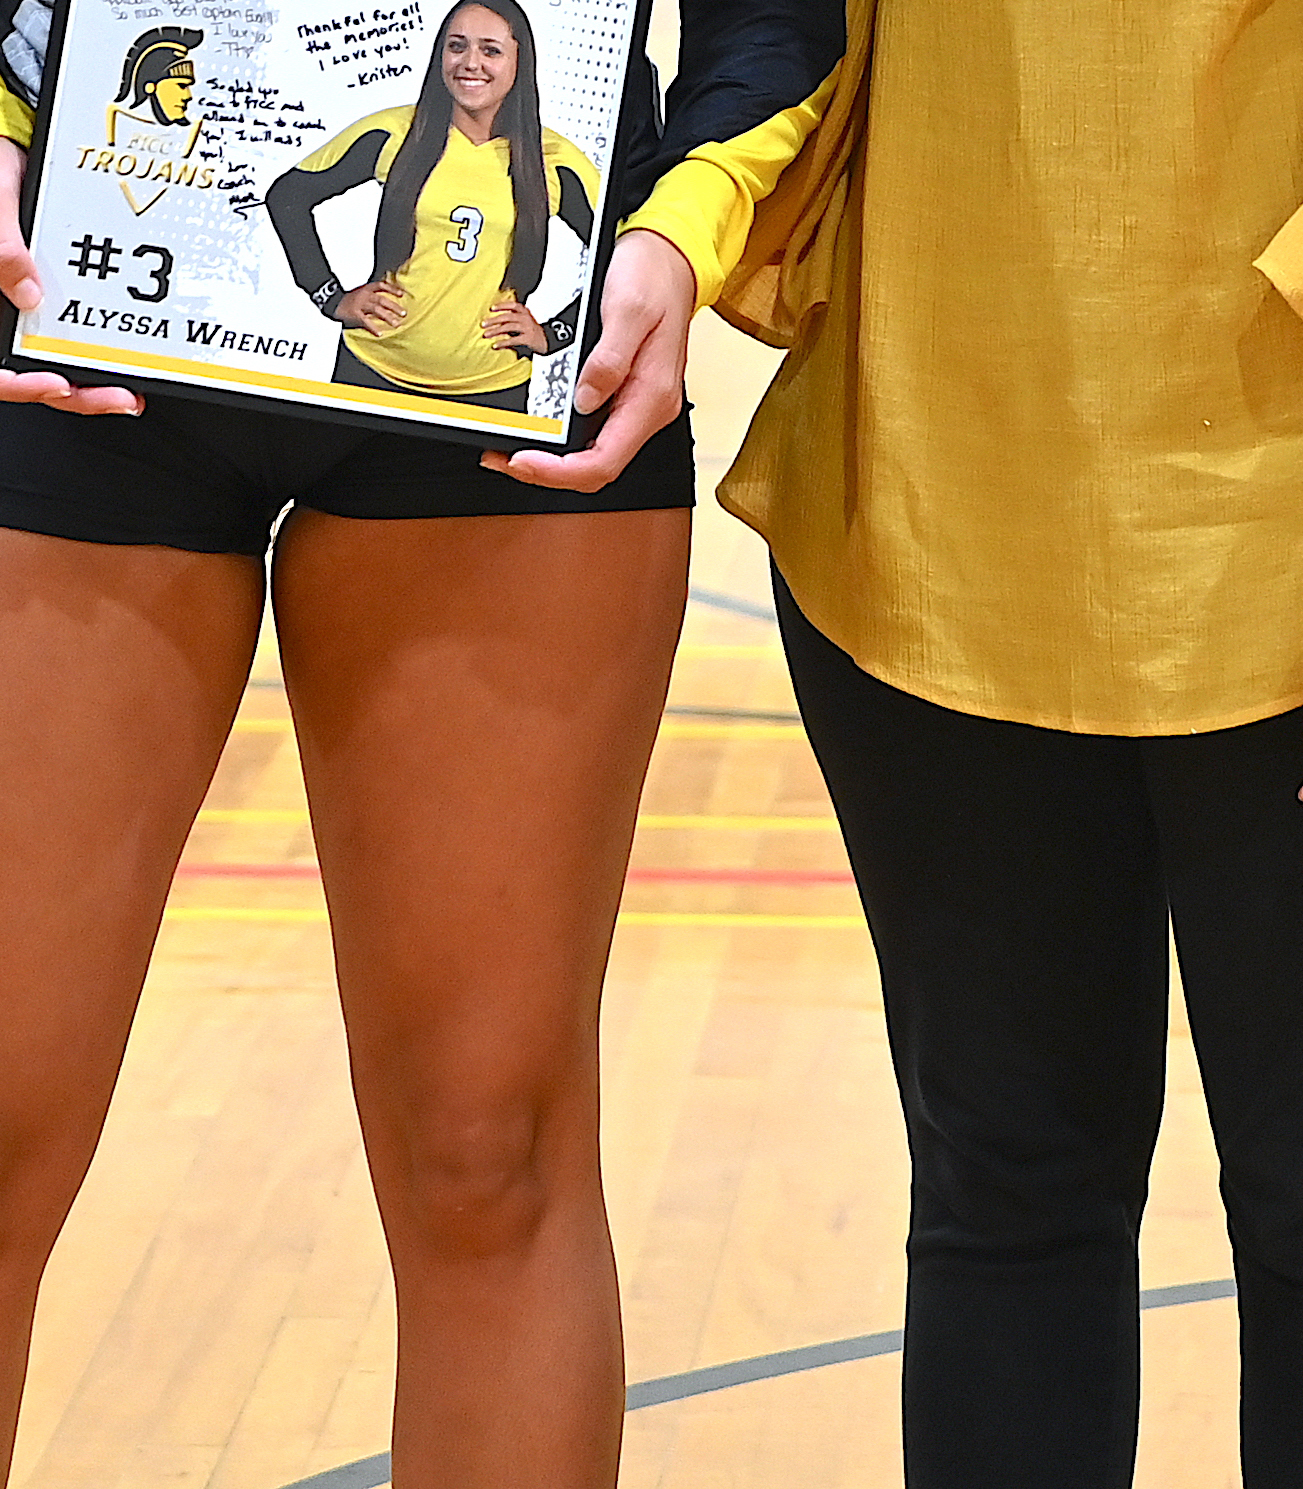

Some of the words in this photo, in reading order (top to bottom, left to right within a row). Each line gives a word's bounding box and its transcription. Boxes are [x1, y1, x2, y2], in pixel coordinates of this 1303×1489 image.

[373, 9, 396, 21] for
[402, 2, 420, 17] all
[211, 22, 224, 35] I
[306, 40, 331, 54] the
[76, 147, 215, 189] TROJANS
[446, 205, 484, 263] 3
[68, 234, 174, 303] #3
